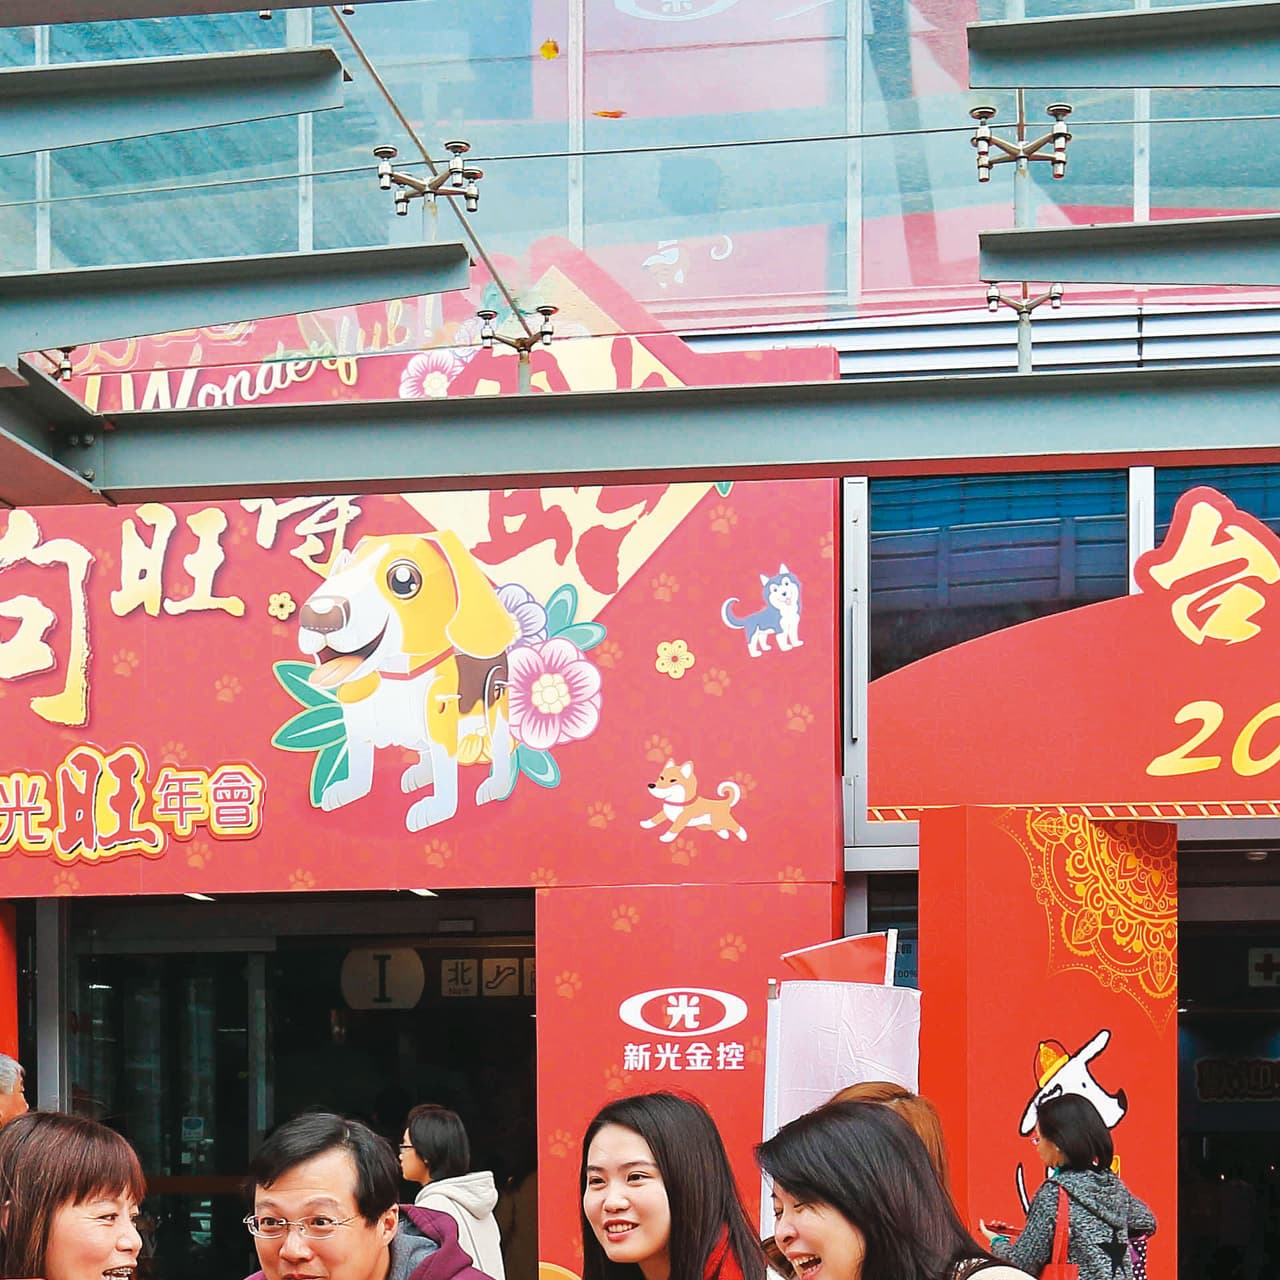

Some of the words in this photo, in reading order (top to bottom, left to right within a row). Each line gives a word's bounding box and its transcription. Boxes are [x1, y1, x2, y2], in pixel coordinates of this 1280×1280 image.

[447, 961, 472, 986] 北
[666, 994, 700, 1029] 光
[623, 1042, 745, 1072] 新光金控
